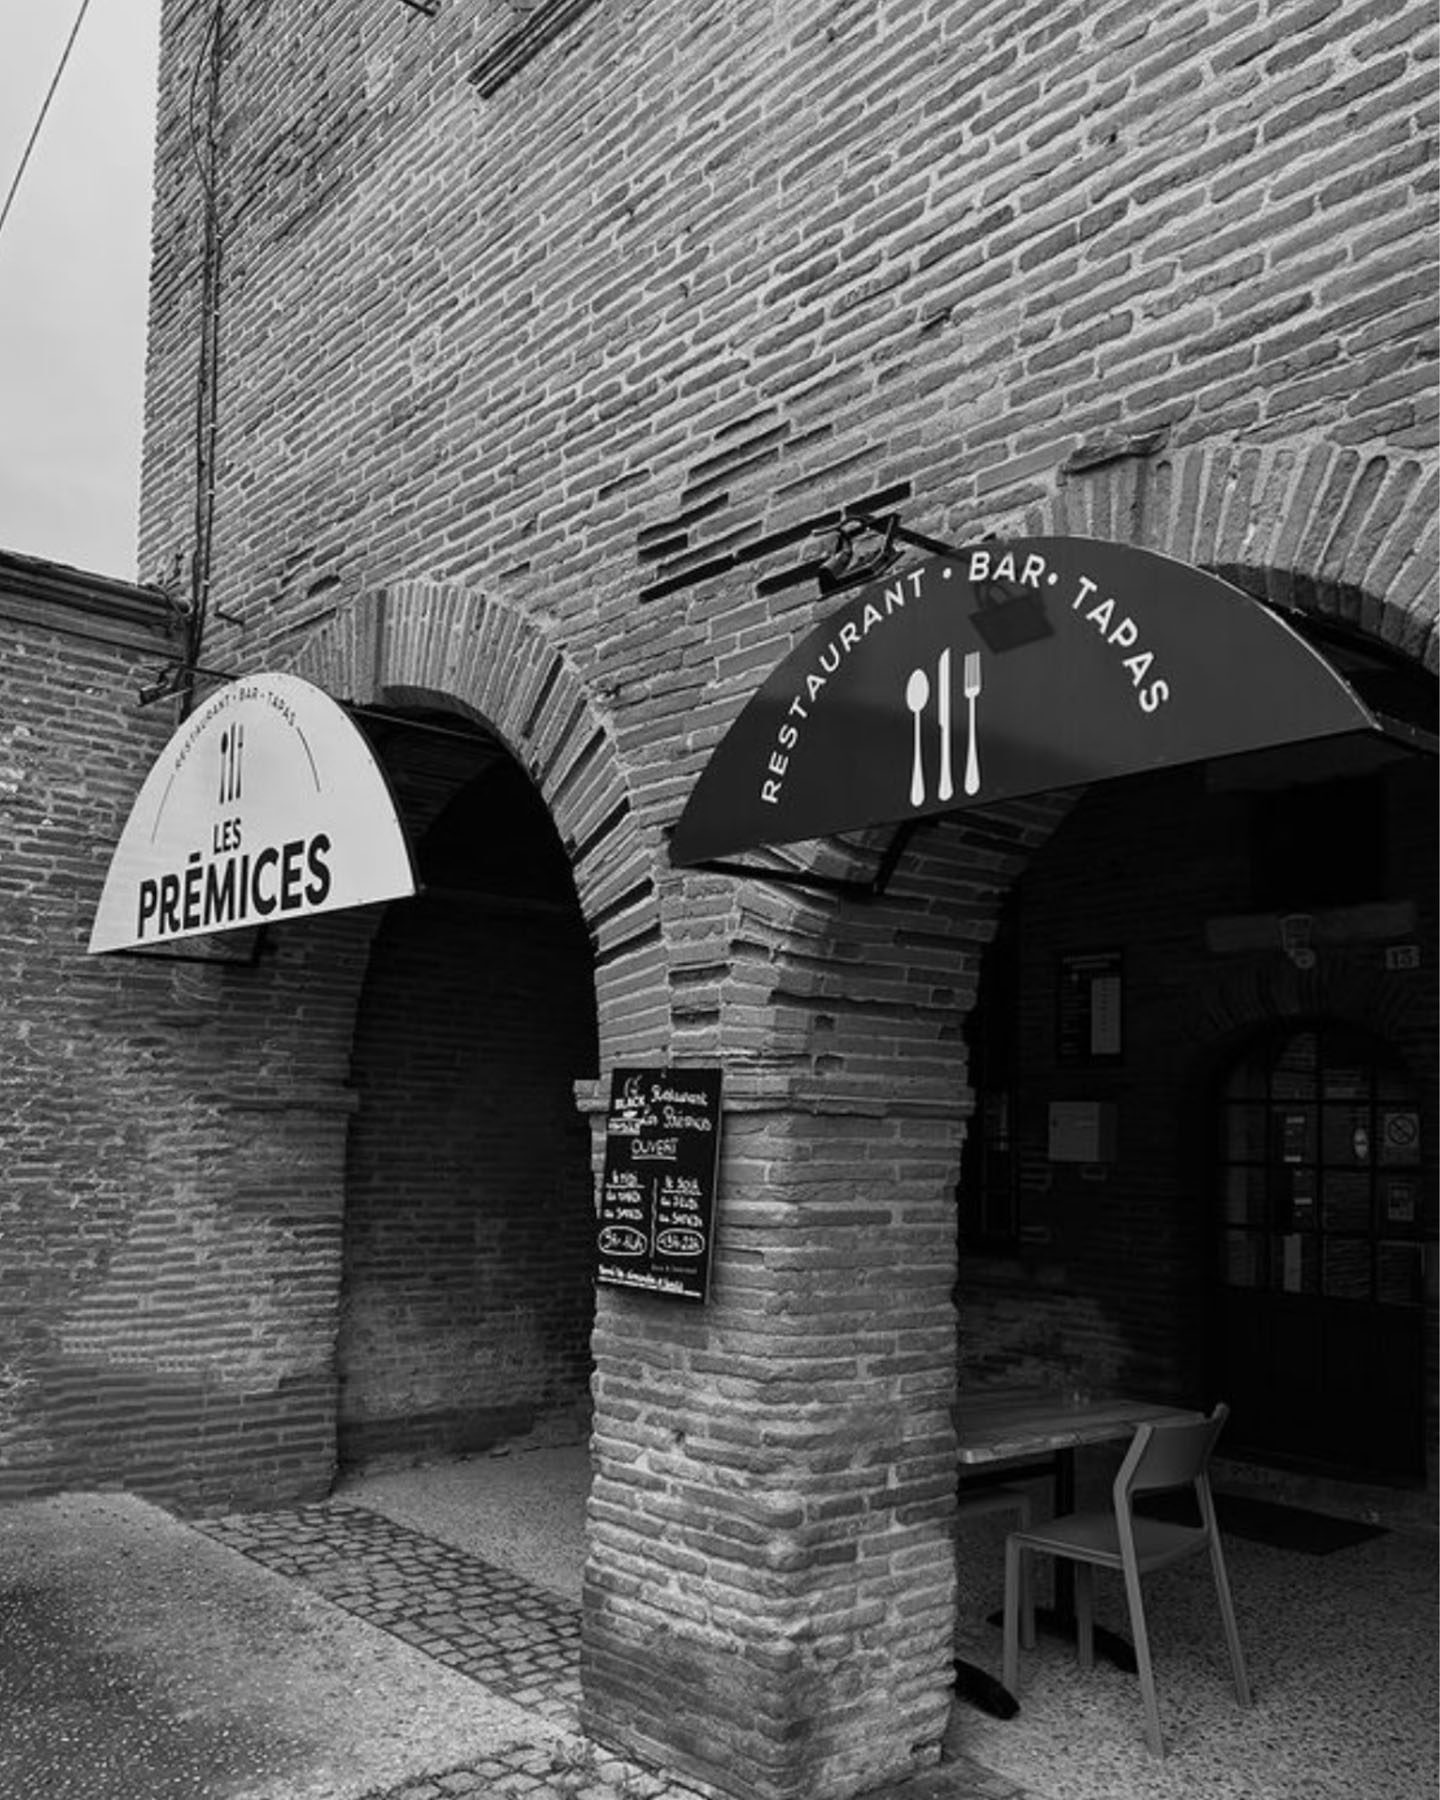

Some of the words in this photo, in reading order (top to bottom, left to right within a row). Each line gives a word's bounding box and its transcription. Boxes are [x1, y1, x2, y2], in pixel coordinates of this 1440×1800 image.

[761, 567, 925, 804] RESTAURANT
[967, 551, 1045, 587] BAR
[1071, 576, 1170, 715] TAPAS
[174, 694, 230, 769] RESTAURANT
[239, 687, 258, 702] BAR
[268, 691, 297, 727] TAPAS
[212, 817, 242, 855] LES
[631, 1137, 679, 1155] OUVERT
